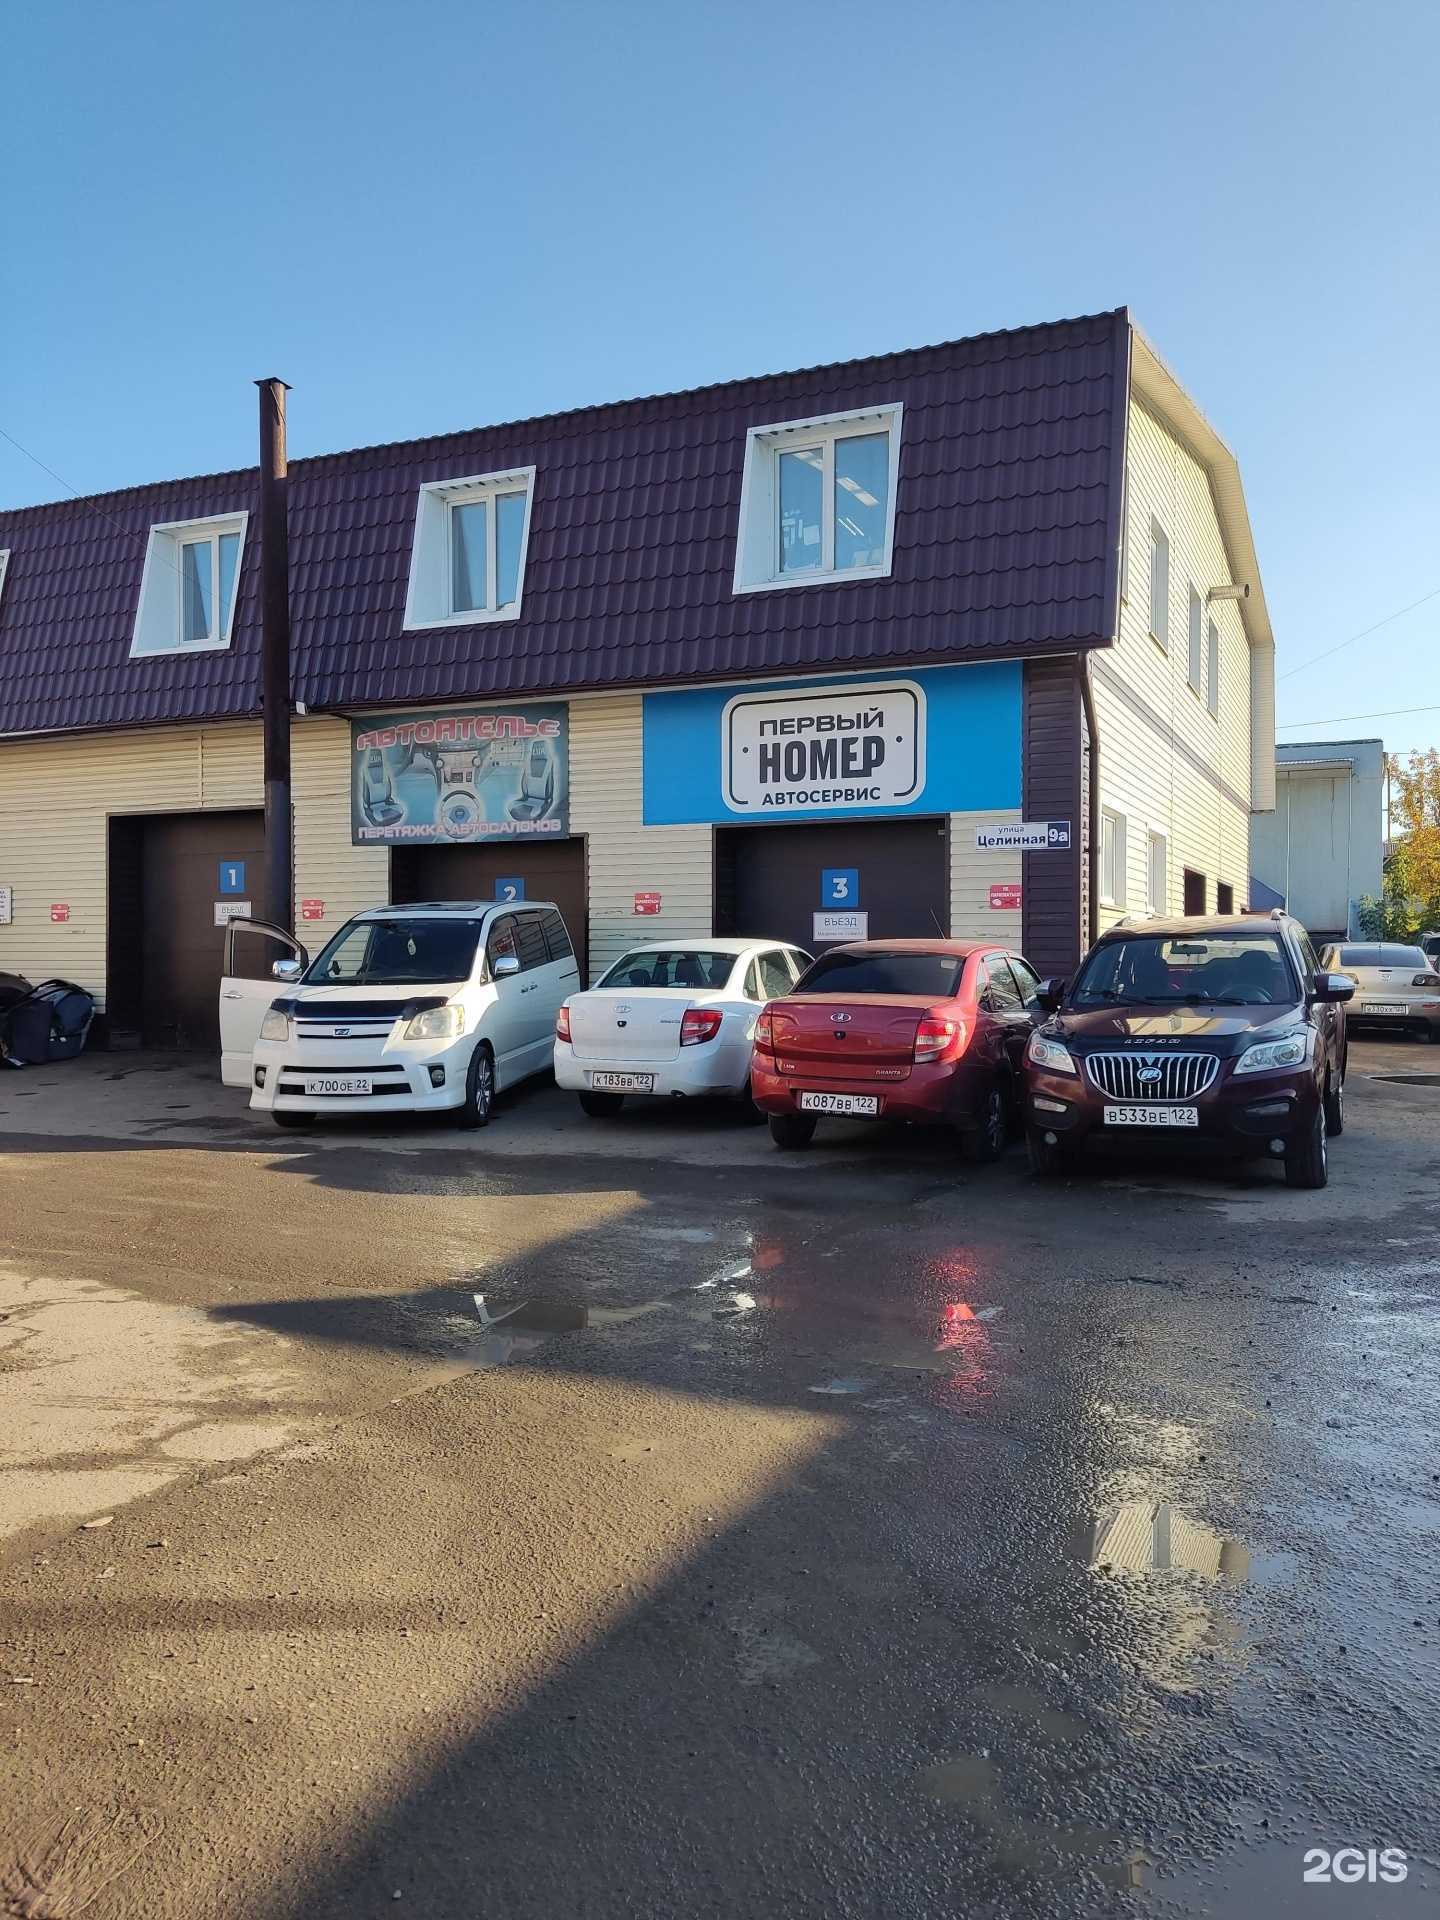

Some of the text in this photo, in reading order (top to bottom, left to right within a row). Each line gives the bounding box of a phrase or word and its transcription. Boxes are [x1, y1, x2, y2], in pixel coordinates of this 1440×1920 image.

[760, 707, 884, 736] ПЕРВЫЙ
[356, 716, 561, 751] АВТОАТЕЛЬЕ
[759, 736, 885, 784] НОМЕР
[762, 787, 881, 805] АВТОСЕРВИС
[358, 819, 562, 839] ПЕРЕТЯЖКА АВТОСАЛОНОВ
[978, 829, 1068, 848] Целинная 9а
[228, 869, 236, 886] 1
[503, 886, 516, 902] 2
[832, 878, 848, 898] 3
[824, 917, 857, 927] ВЪЕЗД
